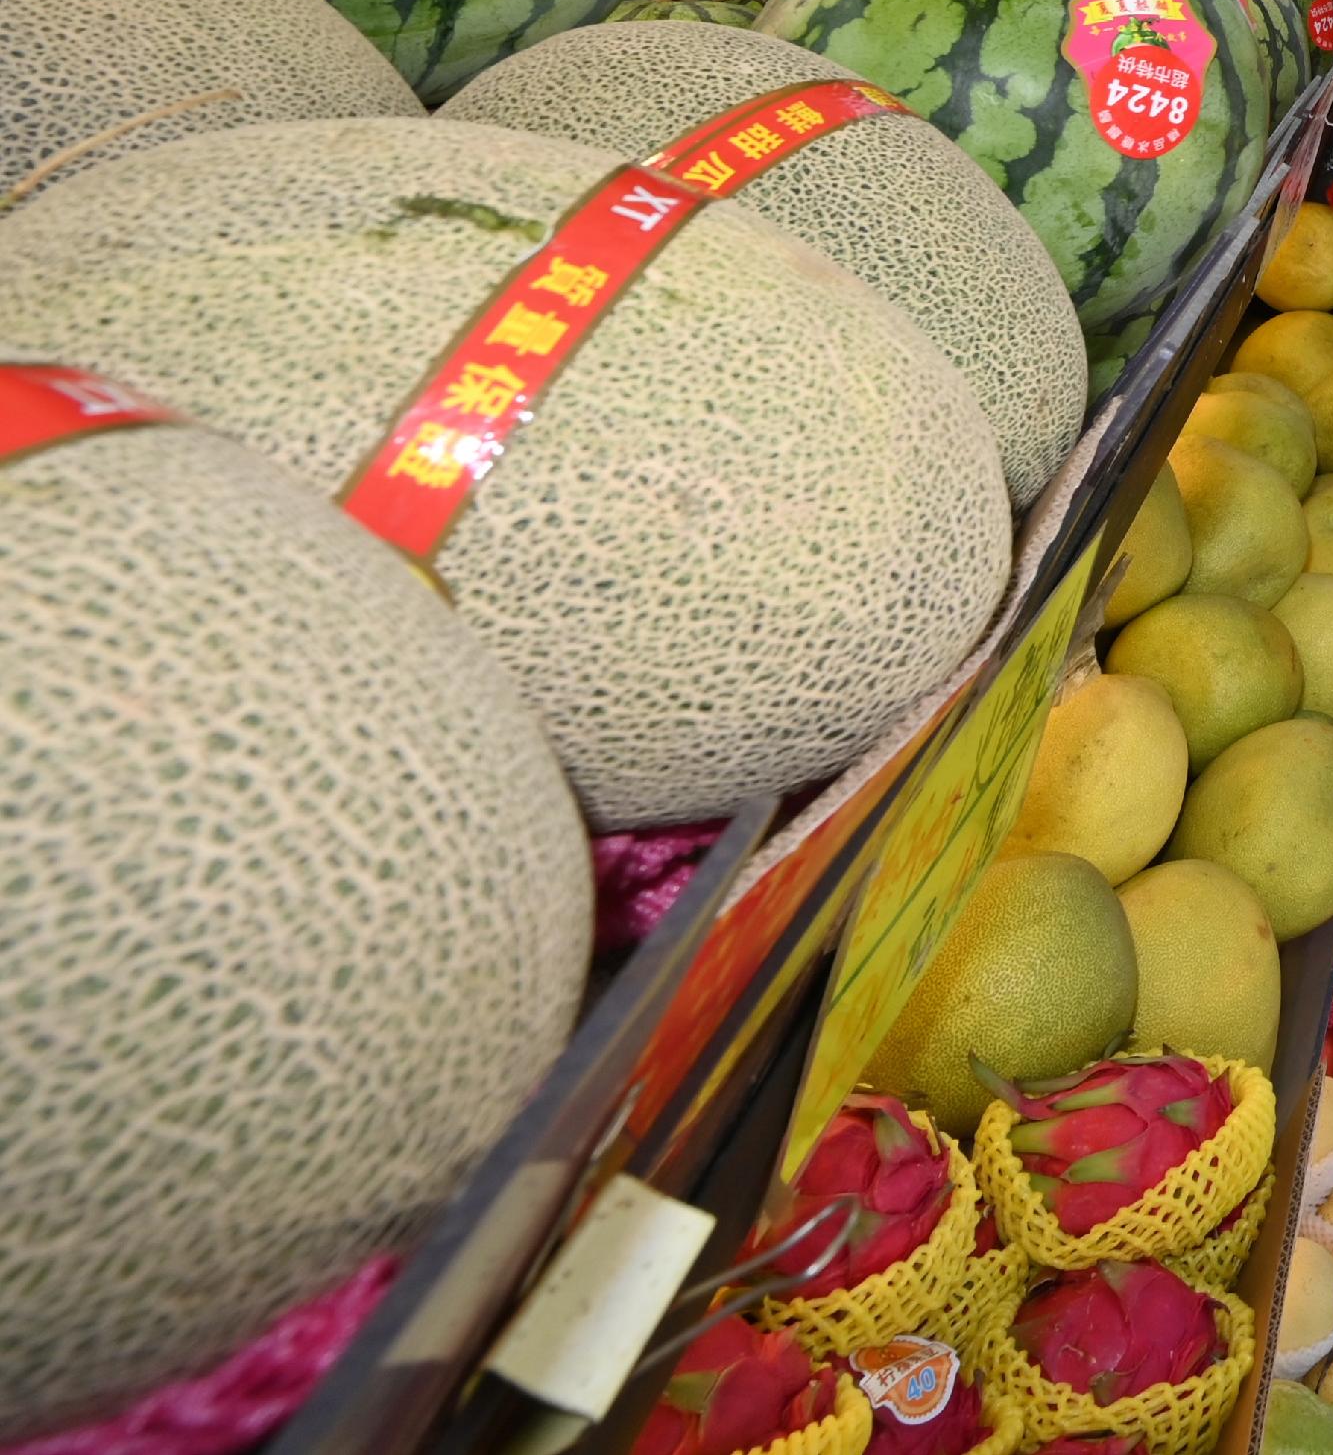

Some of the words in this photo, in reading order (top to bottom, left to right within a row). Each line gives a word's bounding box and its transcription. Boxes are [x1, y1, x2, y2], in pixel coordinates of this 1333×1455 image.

[1105, 77, 1189, 125] 8424
[610, 184, 681, 232] XT
[907, 1365, 936, 1402] 40
